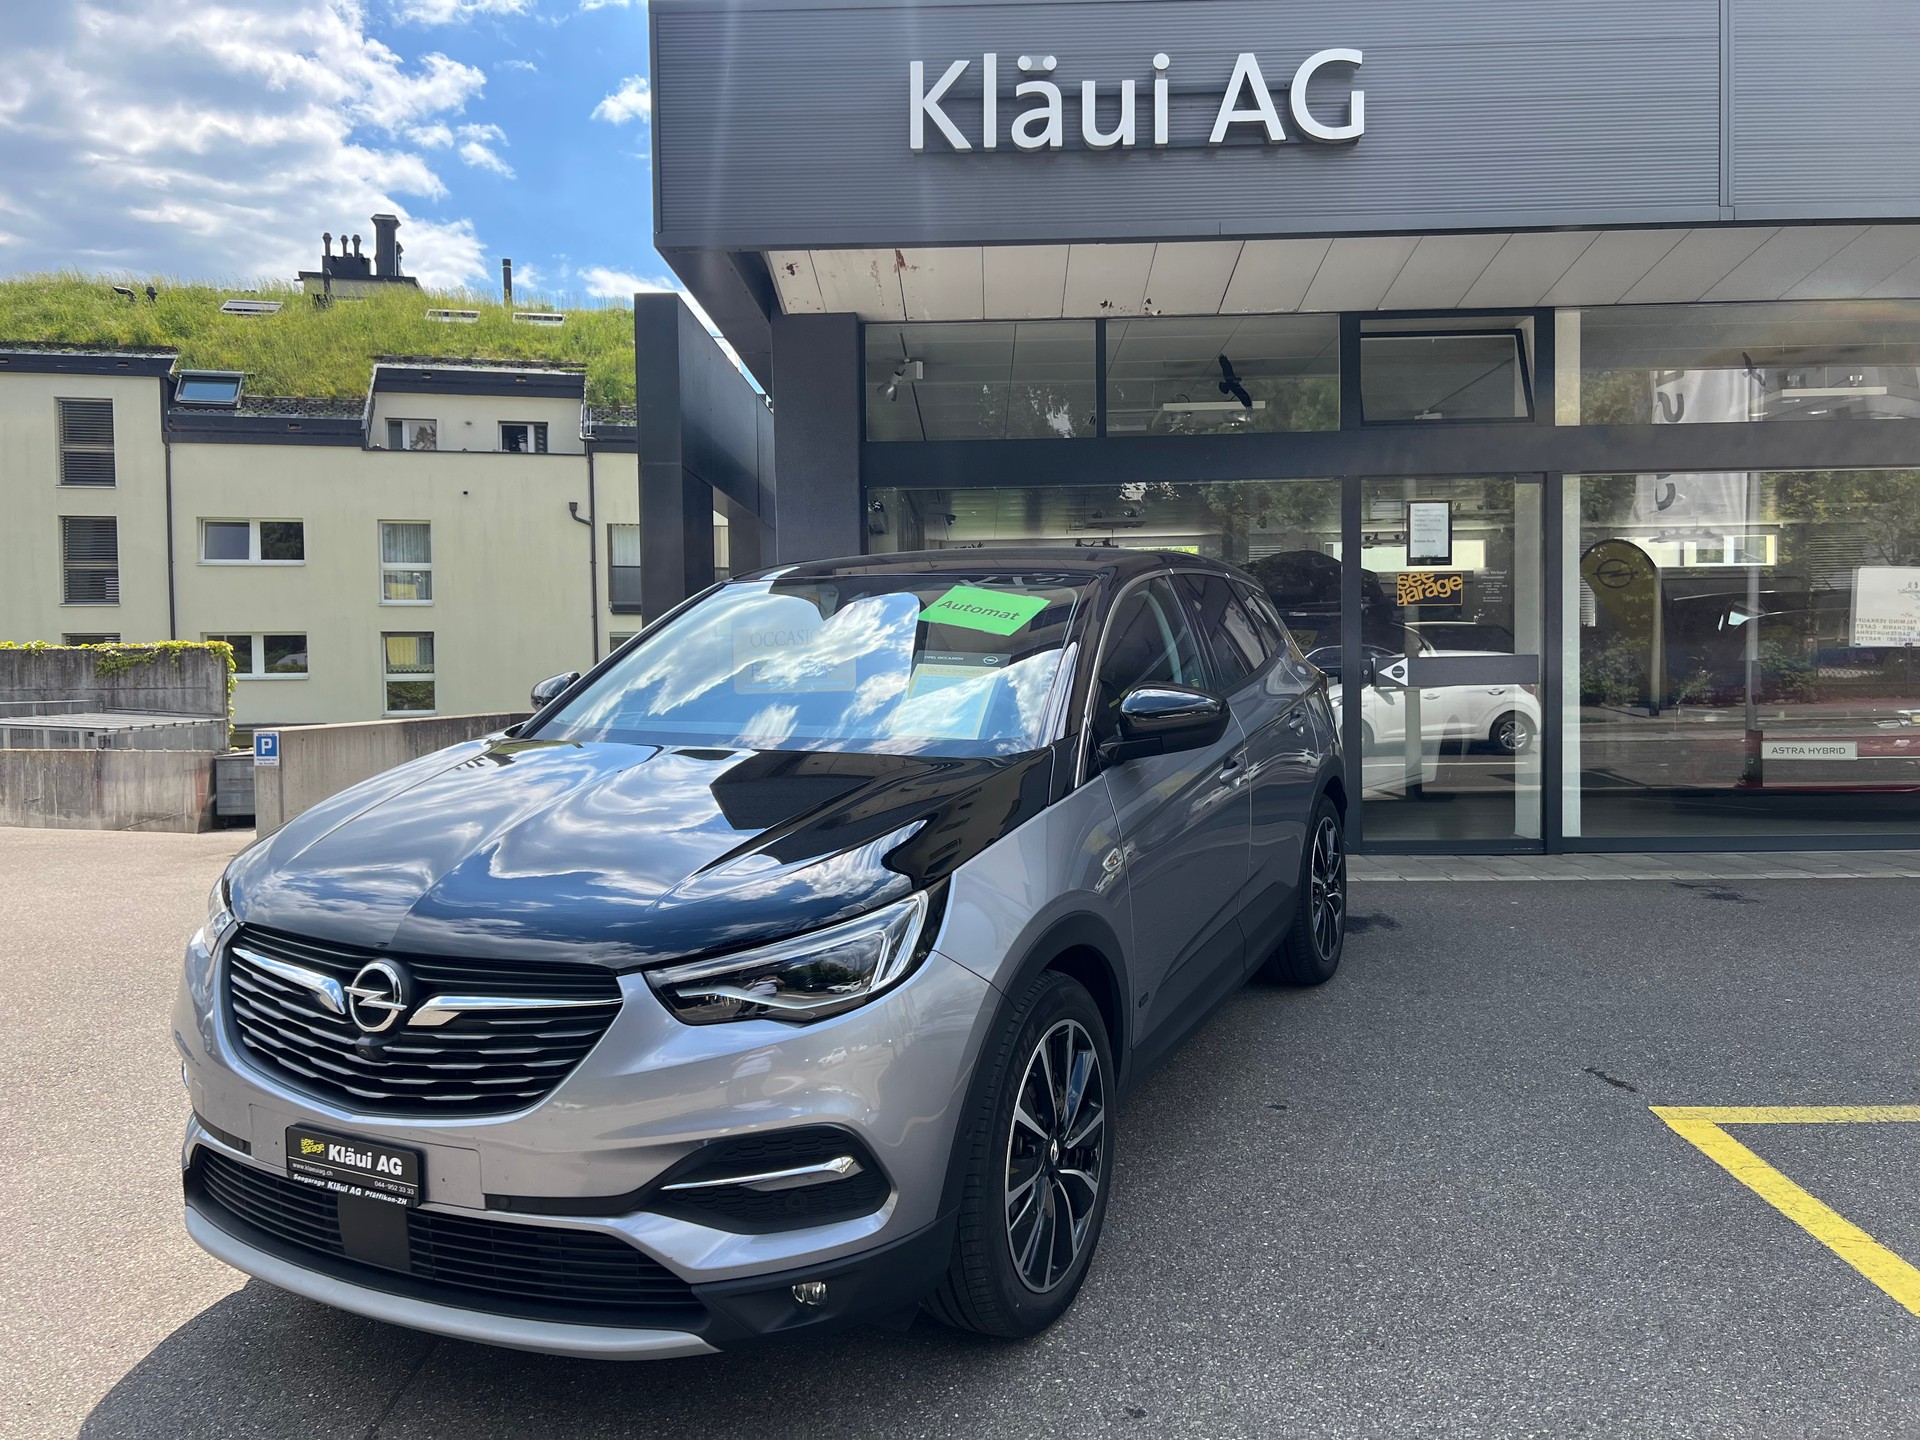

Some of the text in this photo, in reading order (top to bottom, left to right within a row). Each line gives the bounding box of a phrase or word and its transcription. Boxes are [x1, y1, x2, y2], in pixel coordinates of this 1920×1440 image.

[909, 48, 1366, 150] Kläui AG
[1397, 572, 1435, 590] see
[1397, 576, 1463, 605] garage
[937, 600, 1020, 621] Automat
[261, 738, 272, 755] P
[1771, 746, 1846, 755] ASTRA HYBRID
[328, 1143, 403, 1176] Kläui AG
[293, 1173, 325, 1187] Seegarage
[327, 1180, 349, 1193] Kläui
[349, 1186, 362, 1196] AG
